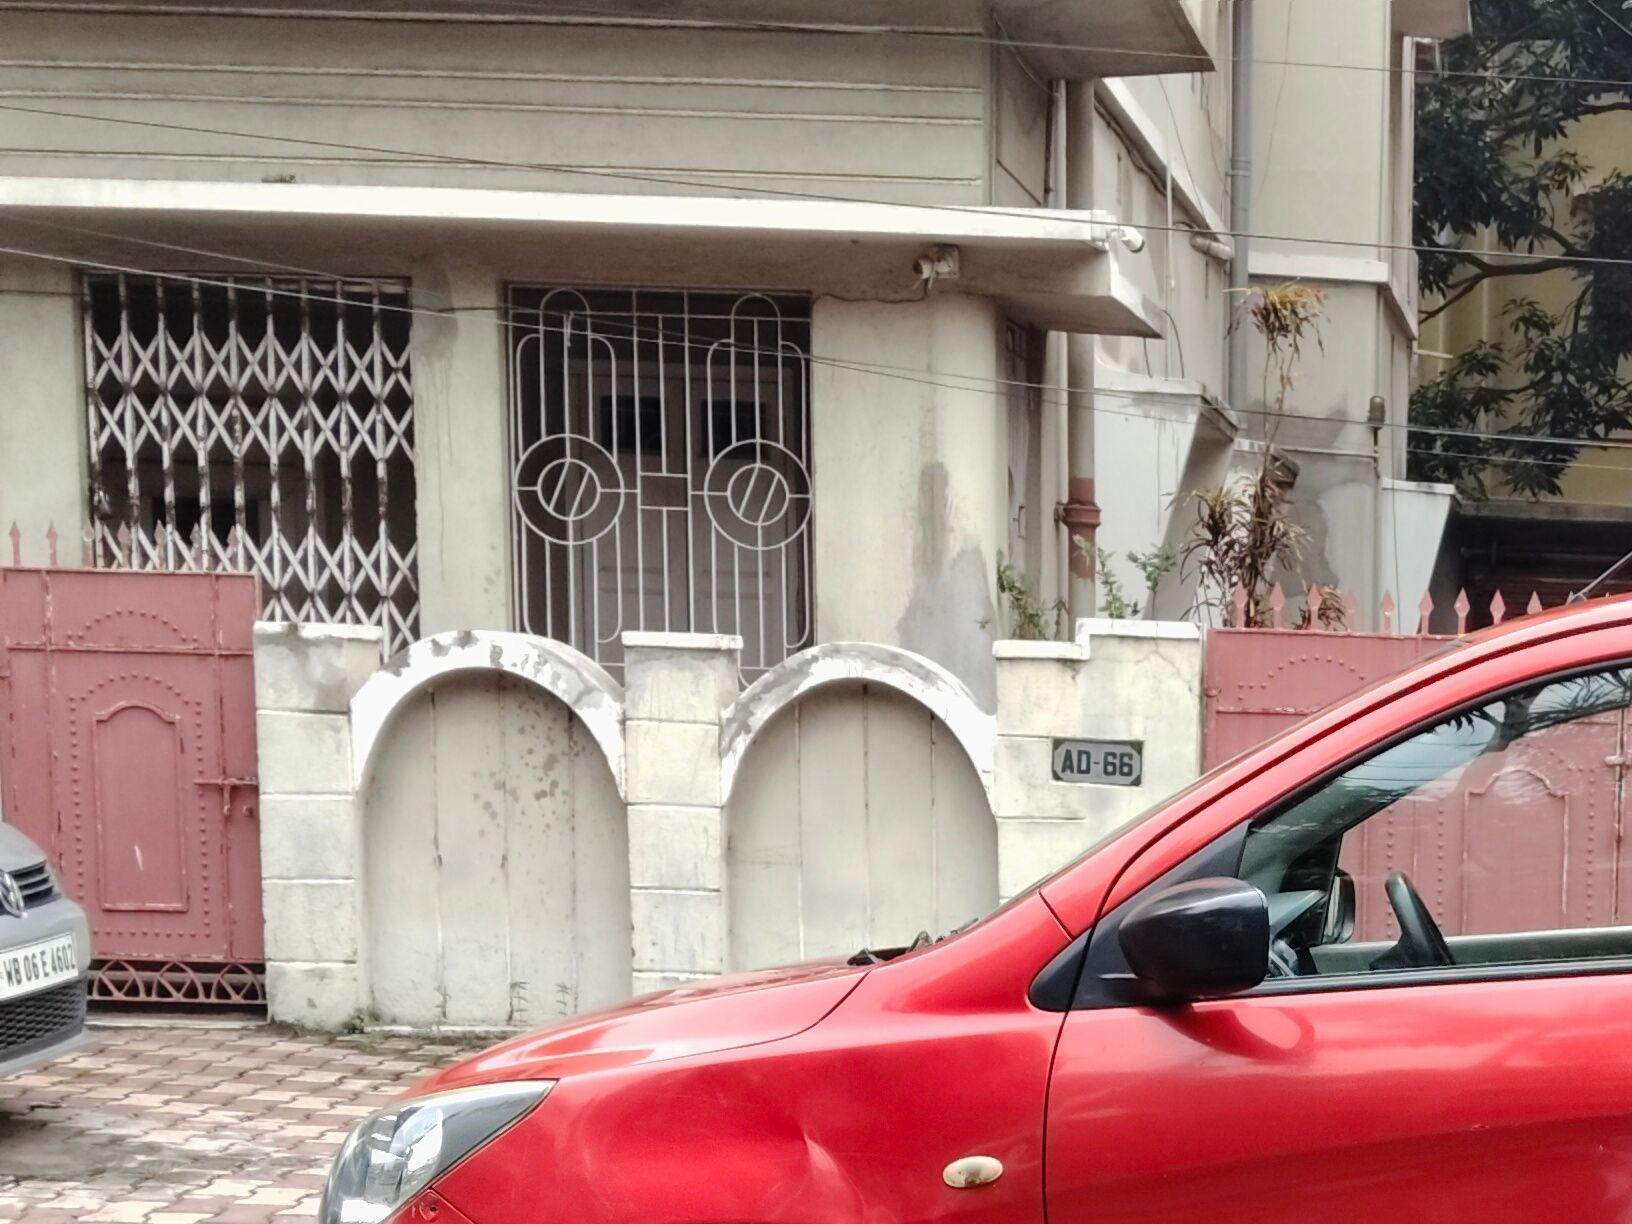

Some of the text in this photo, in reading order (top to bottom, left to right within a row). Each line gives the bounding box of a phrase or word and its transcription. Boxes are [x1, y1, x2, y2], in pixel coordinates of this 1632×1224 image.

[1061, 749, 1133, 777] AD-66
[3, 943, 76, 987] WB 06 E 4602
